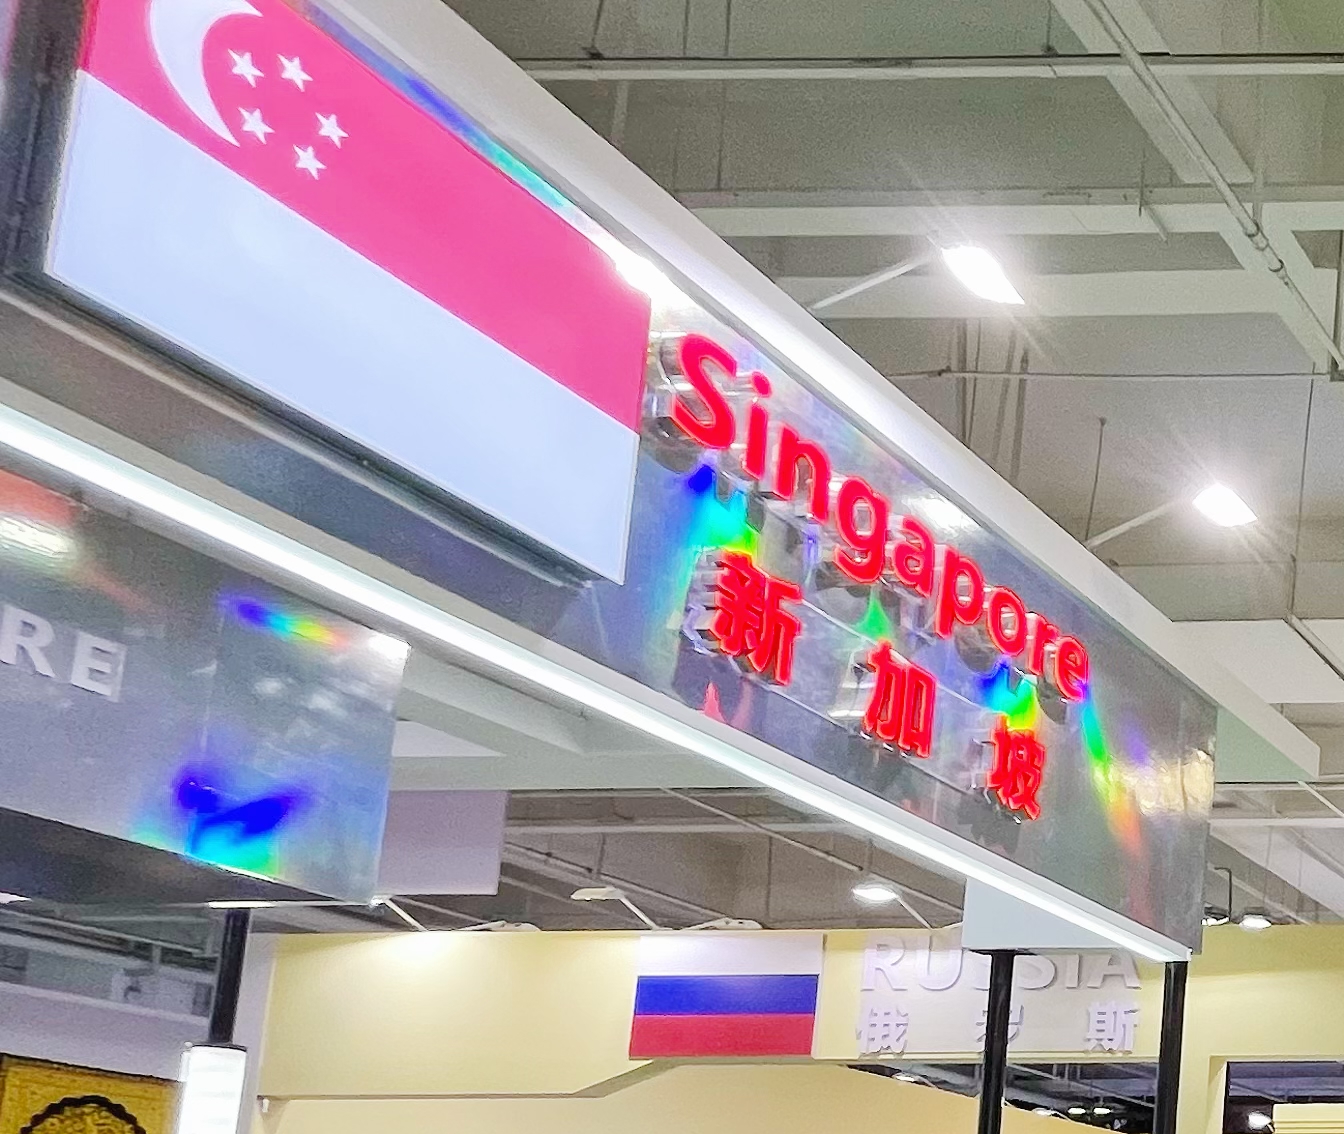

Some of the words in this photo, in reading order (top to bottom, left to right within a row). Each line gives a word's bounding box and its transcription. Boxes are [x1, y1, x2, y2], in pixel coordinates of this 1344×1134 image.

[668, 333, 1090, 702] Singapore
[709, 551, 1048, 821] 新加坡
